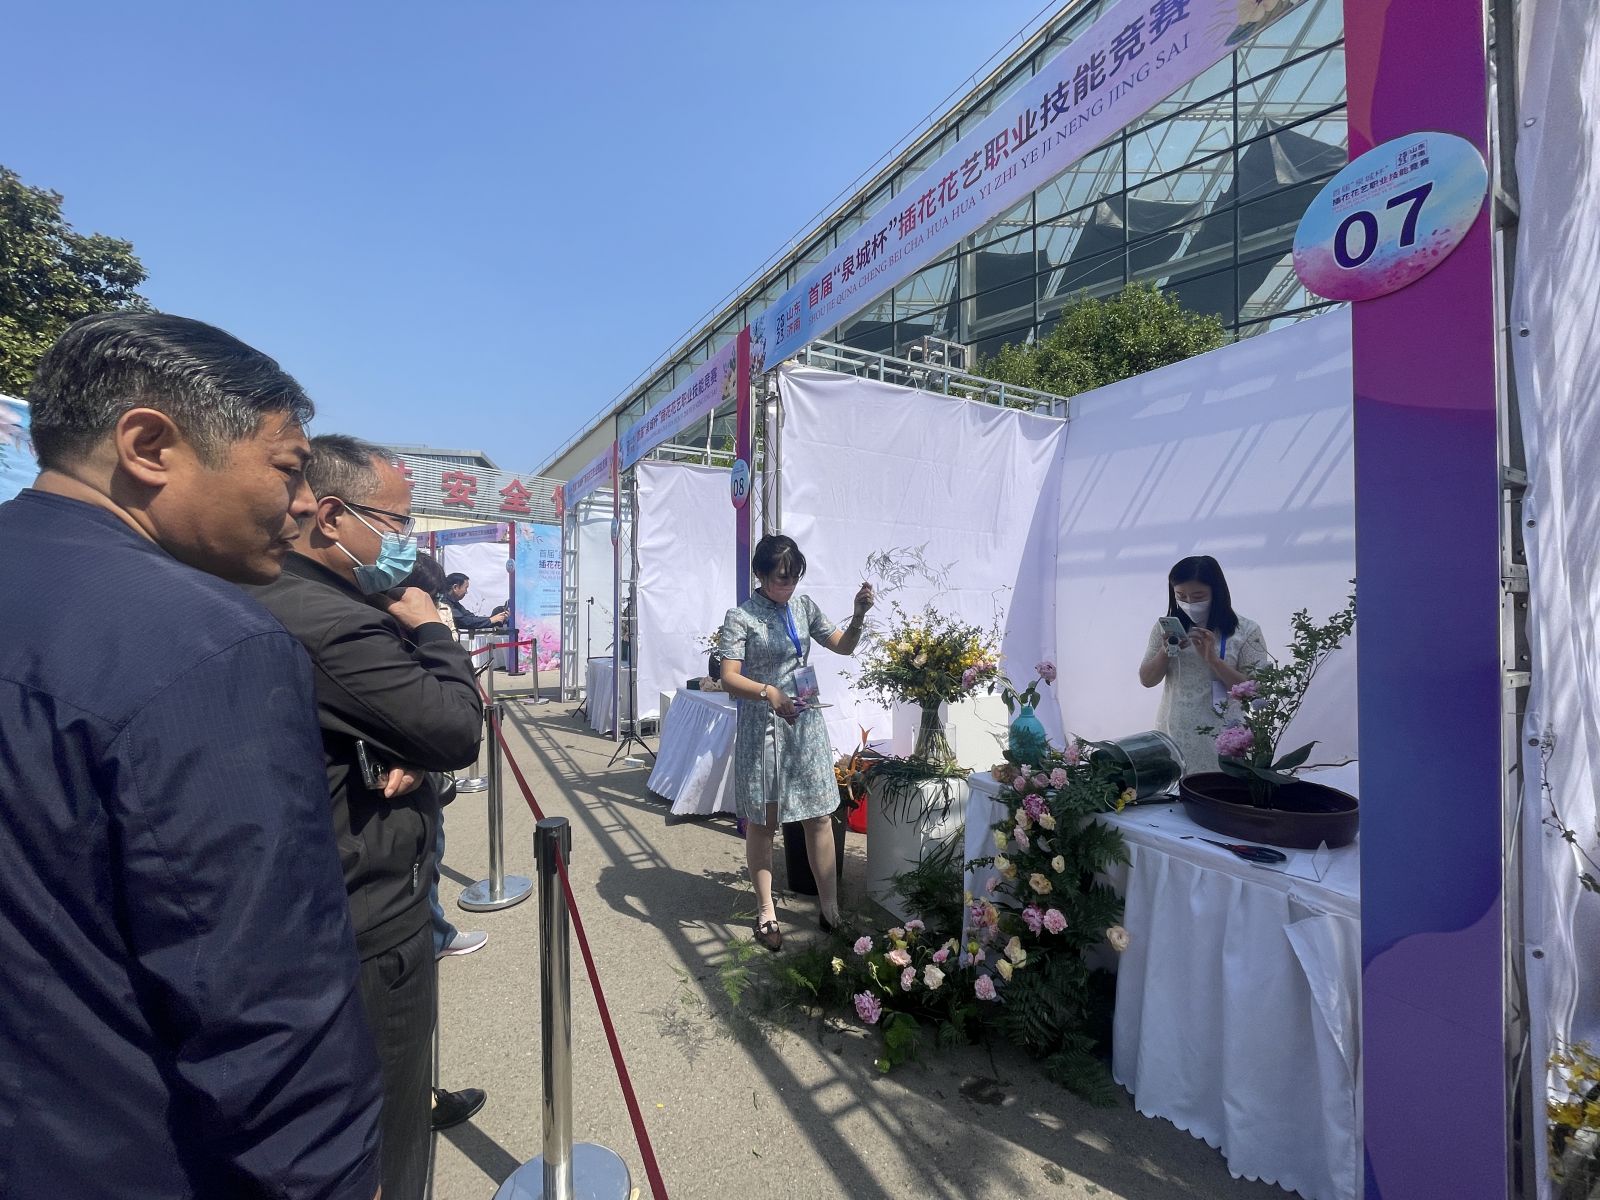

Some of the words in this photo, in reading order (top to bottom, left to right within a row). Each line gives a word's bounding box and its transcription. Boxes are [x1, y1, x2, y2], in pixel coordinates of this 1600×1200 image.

[858, 264, 887, 288] CHENG
[888, 250, 902, 267] BEI
[904, 236, 925, 255] CHA
[927, 216, 949, 239] HUA
[952, 199, 977, 222] HUA
[979, 181, 994, 199] YI
[994, 163, 1018, 189] ZHI
[1021, 151, 1039, 171] YE
[1041, 137, 1053, 159] JI
[1055, 98, 1104, 146] NENG
[1107, 62, 1151, 110] JING
[1155, 32, 1191, 71] SAI
[1333, 181, 1433, 268] 07
[733, 477, 744, 497] 08
